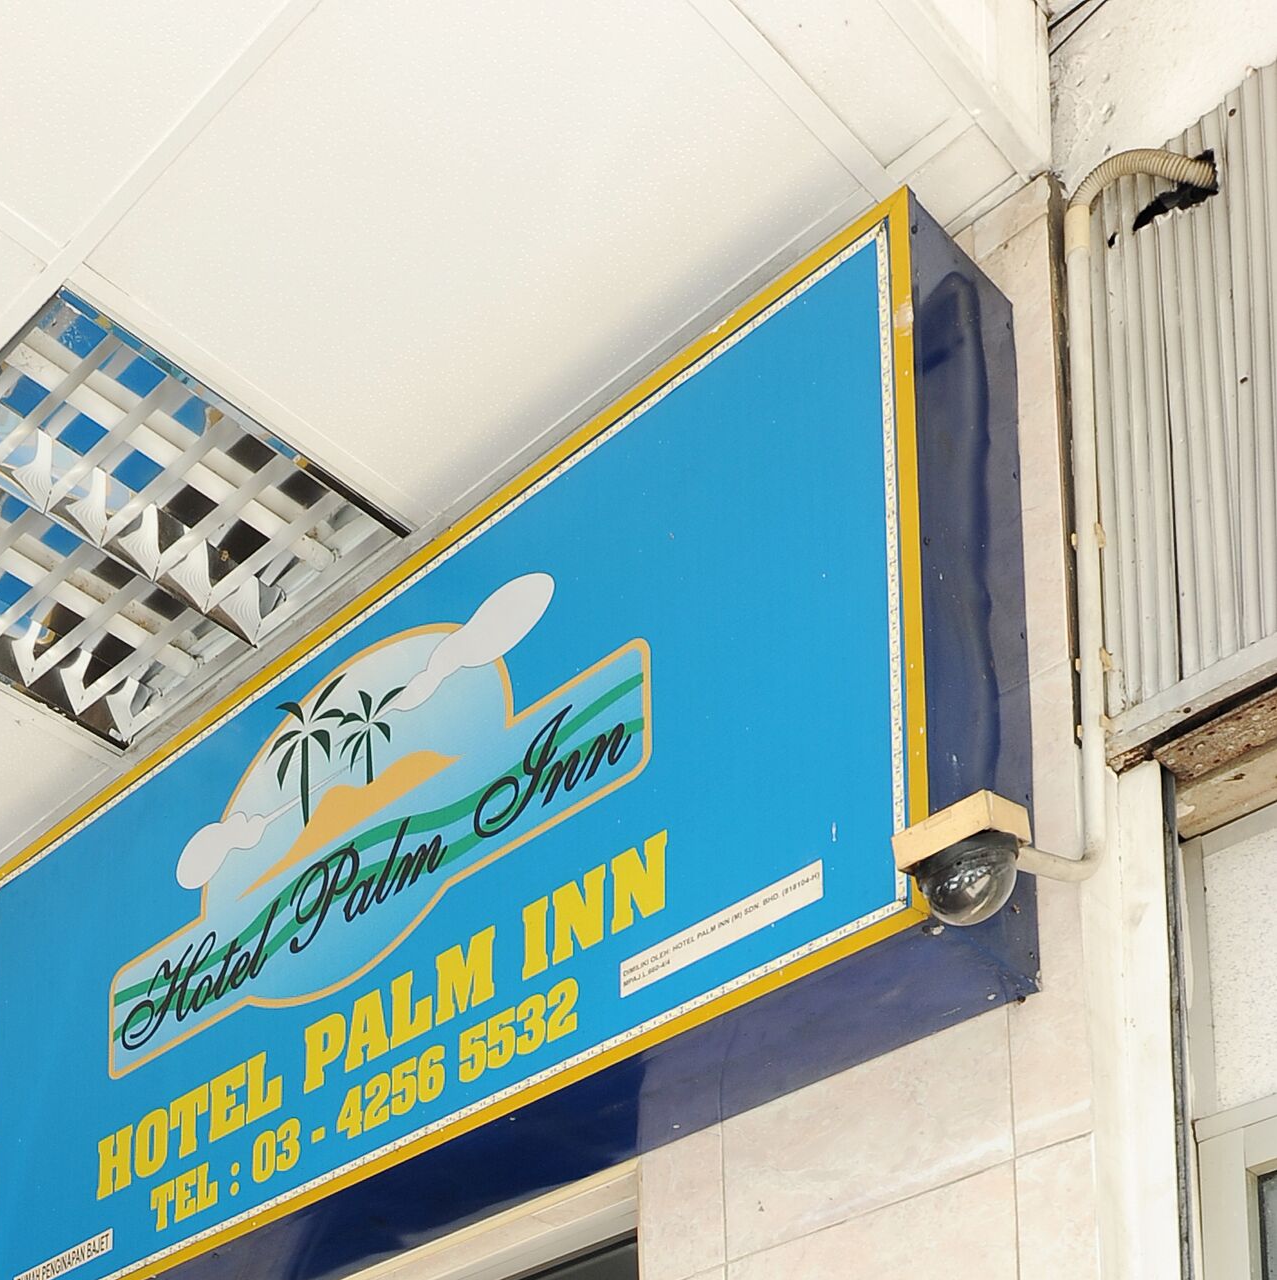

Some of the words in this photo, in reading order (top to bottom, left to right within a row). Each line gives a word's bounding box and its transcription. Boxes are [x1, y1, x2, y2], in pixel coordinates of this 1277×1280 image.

[122, 898, 280, 1051] Hotel
[290, 816, 449, 954] Palm
[474, 704, 633, 839] Inn
[672, 936, 695, 952] HOTEL
[697, 924, 717, 939] PALM
[718, 917, 731, 928] INN
[98, 1053, 282, 1199] HOTEL
[304, 926, 495, 1093] PALM
[523, 831, 667, 979] INN
[151, 1162, 219, 1230] TEL
[253, 1119, 301, 1181] 03
[338, 1046, 444, 1138] 4256
[460, 978, 578, 1081] 5532
[42, 1246, 85, 1279] PENGINAPAN
[87, 1233, 110, 1258] BAJET
